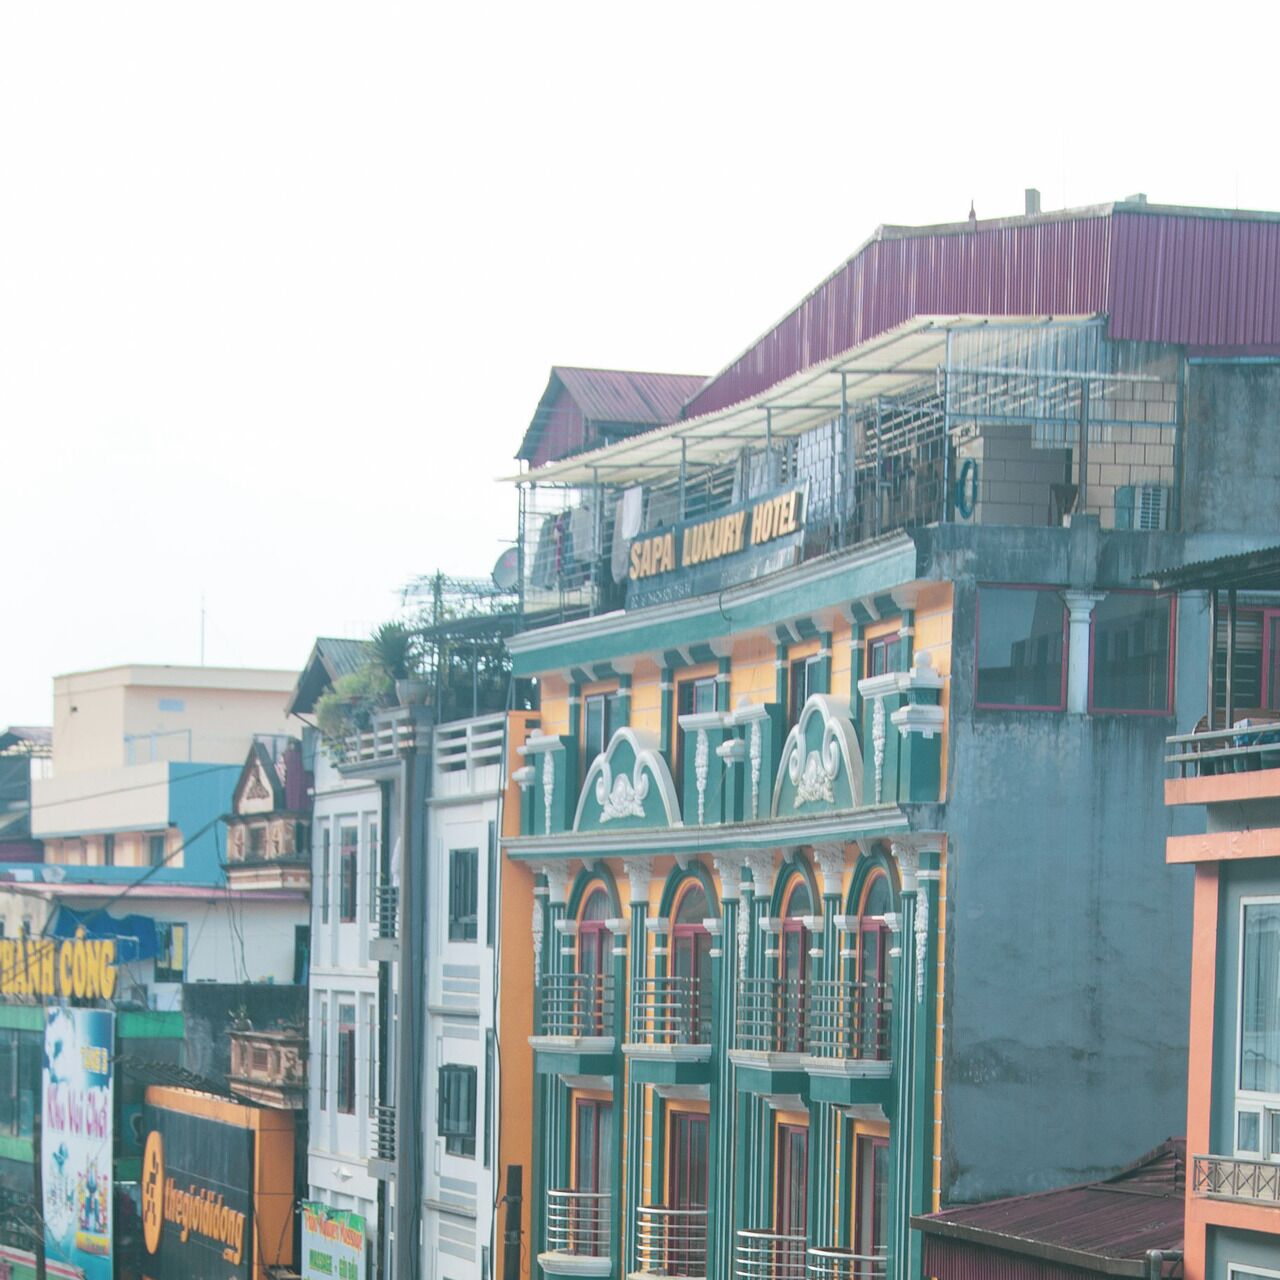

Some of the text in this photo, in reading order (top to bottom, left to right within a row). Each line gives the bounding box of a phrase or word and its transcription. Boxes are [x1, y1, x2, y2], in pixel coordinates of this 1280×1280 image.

[629, 533, 676, 581] SAPA
[682, 510, 747, 567] LUXURY
[750, 490, 800, 546] HOTEL
[59, 924, 116, 1000] CÔNG
